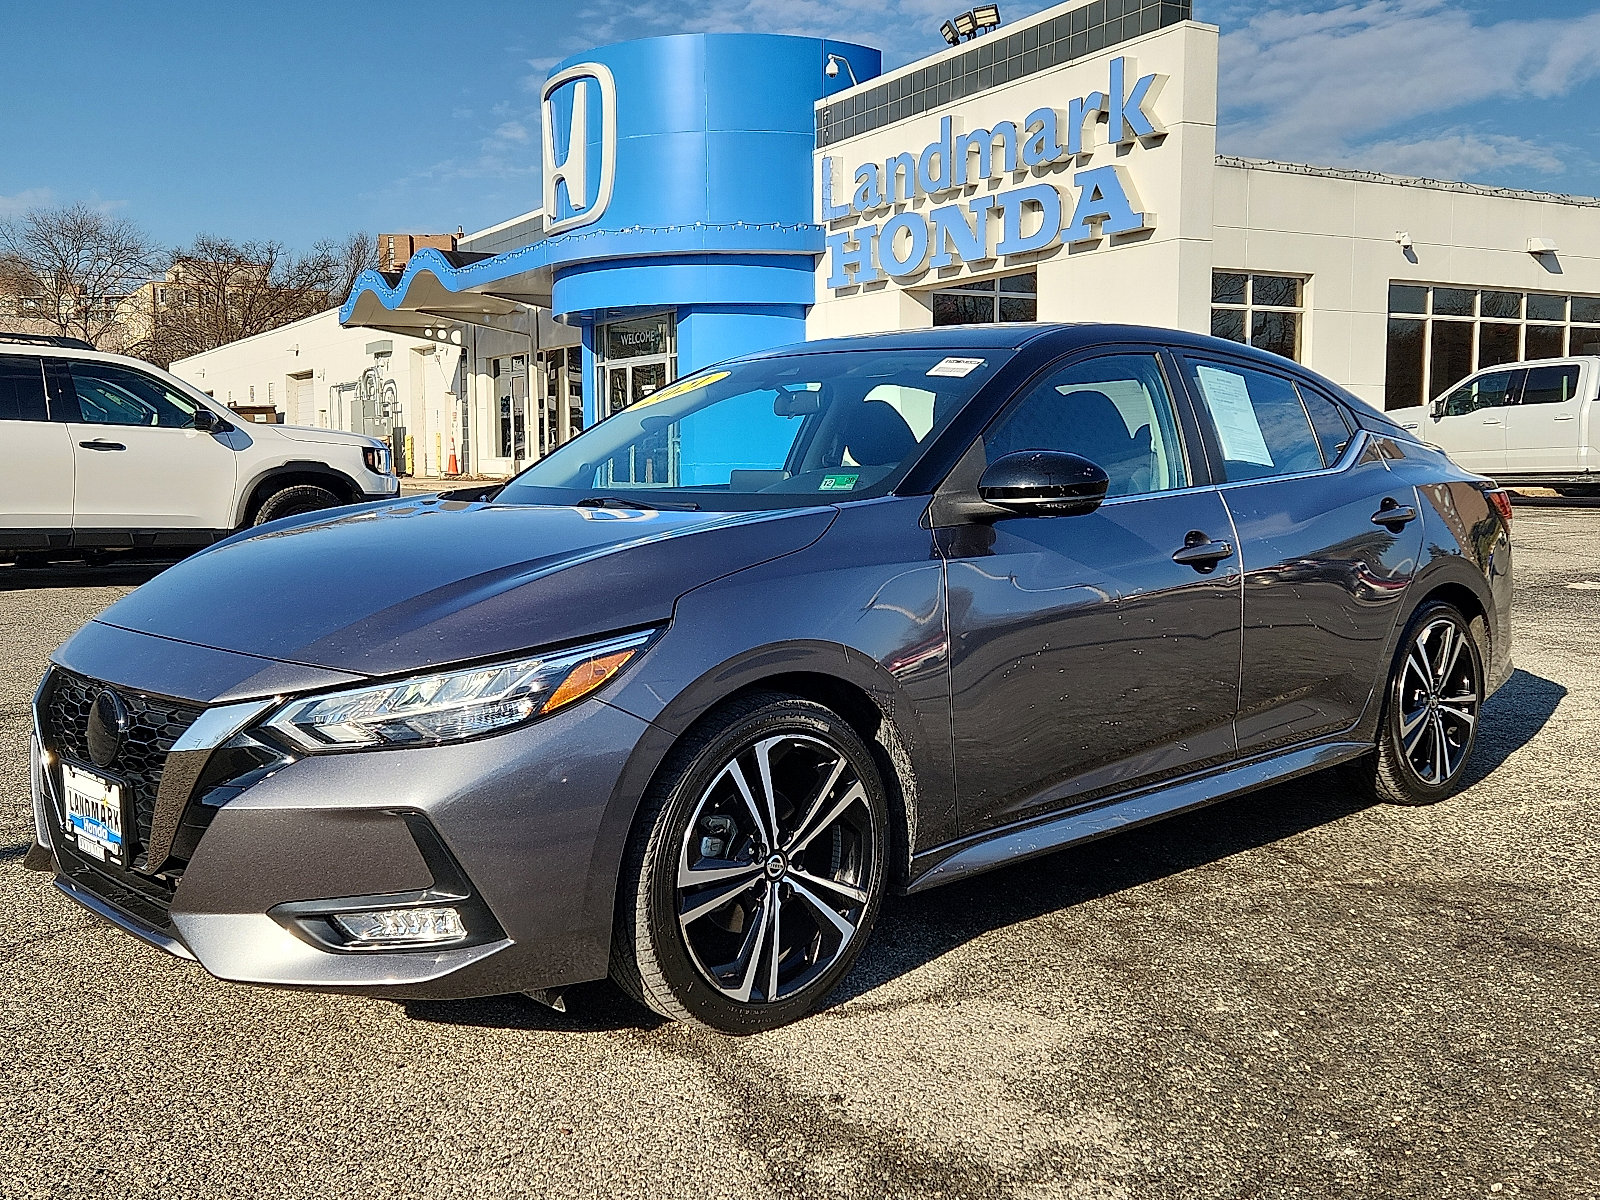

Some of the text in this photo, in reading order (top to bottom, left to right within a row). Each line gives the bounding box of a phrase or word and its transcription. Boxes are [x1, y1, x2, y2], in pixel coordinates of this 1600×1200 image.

[822, 56, 1160, 224] Landmark
[826, 165, 1149, 291] HONDA
[69, 789, 120, 833] LANDMARK
[84, 817, 109, 841] Honda
